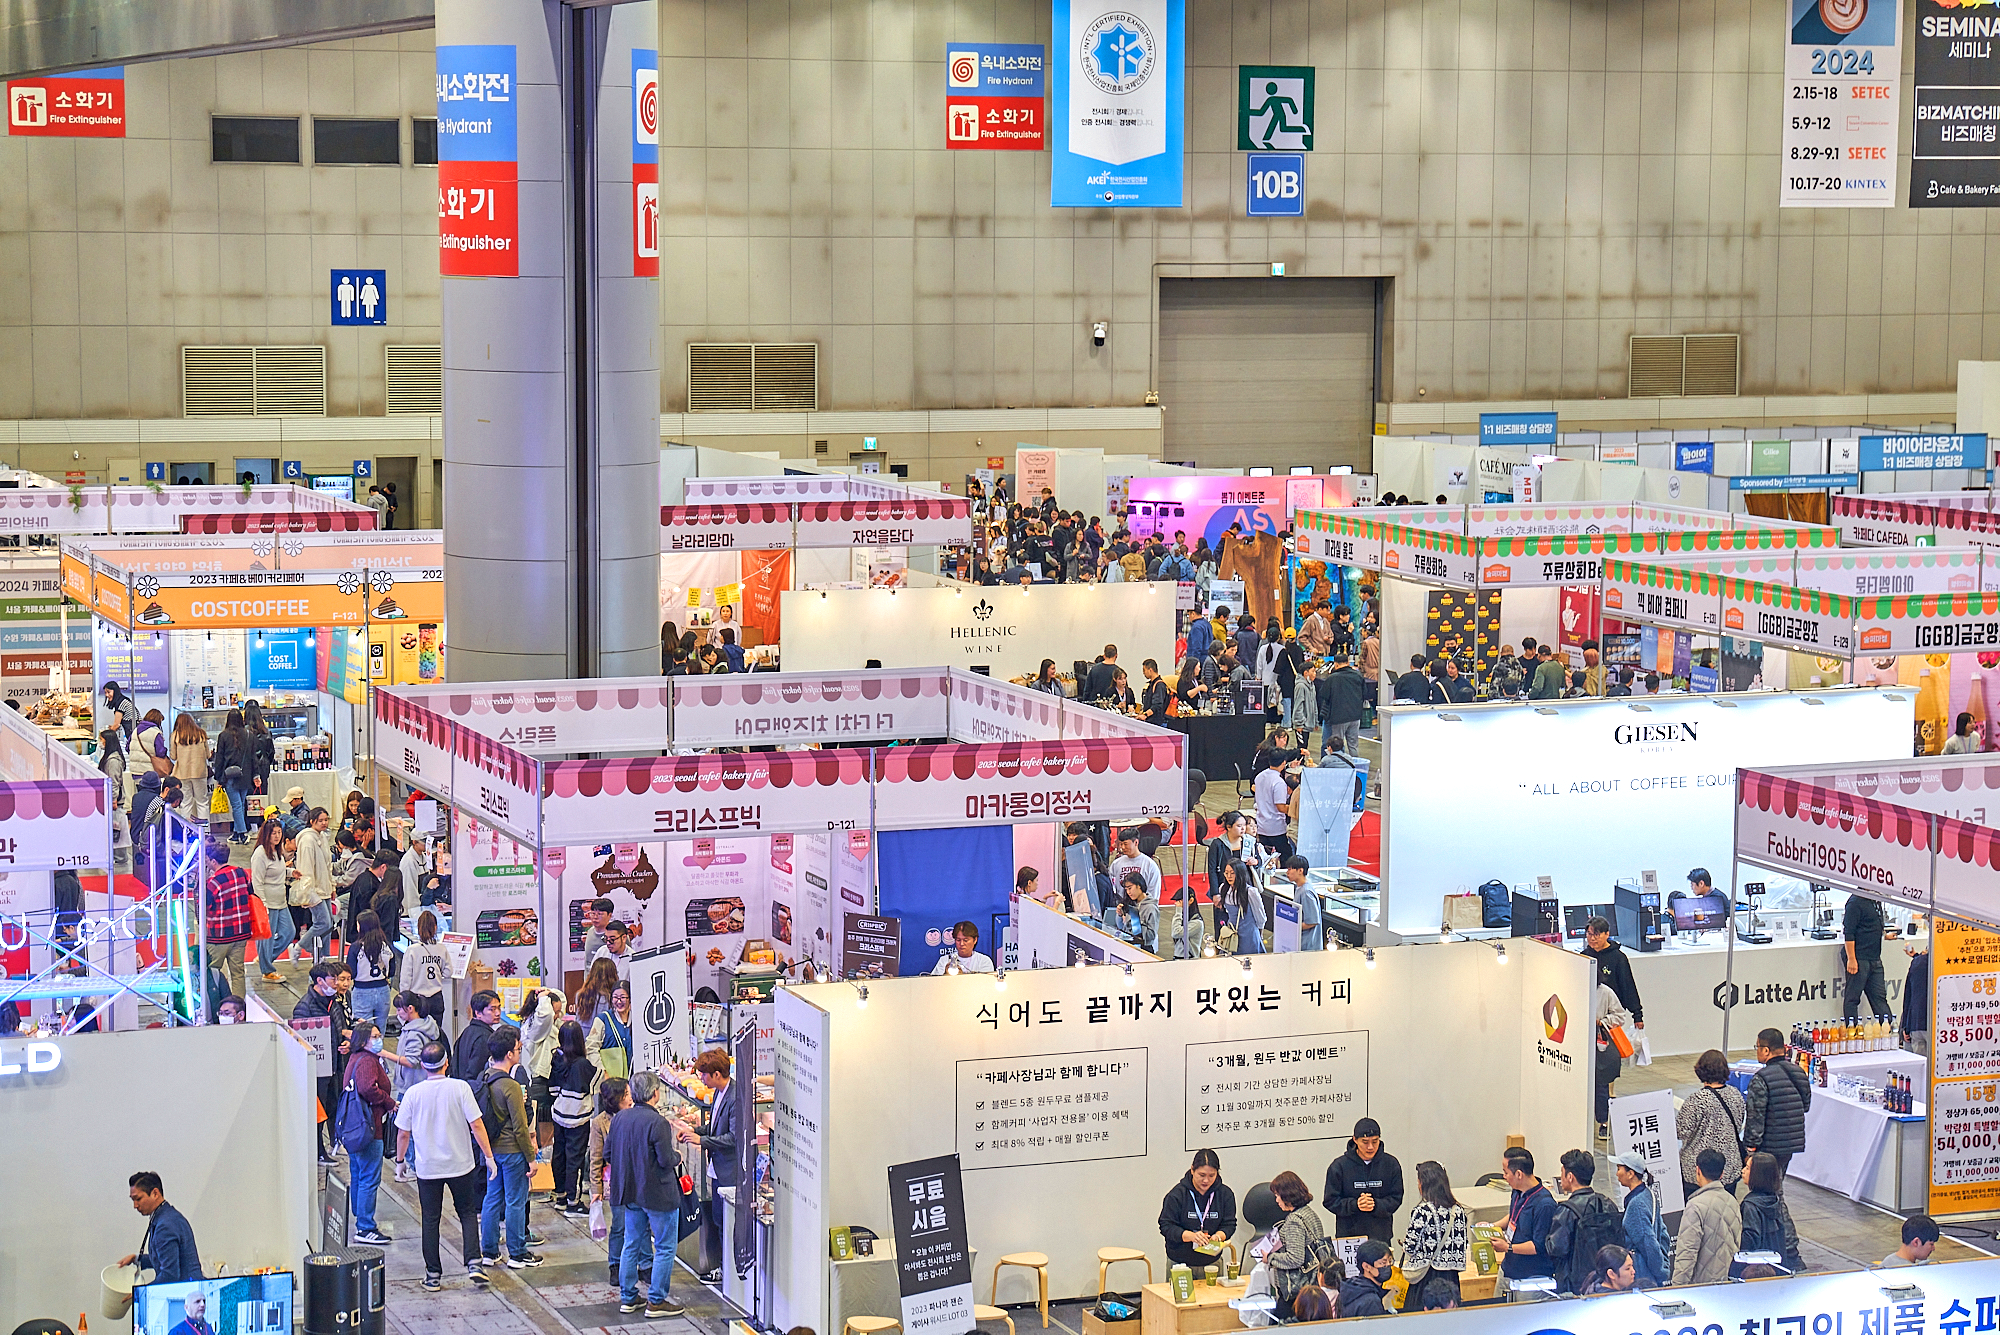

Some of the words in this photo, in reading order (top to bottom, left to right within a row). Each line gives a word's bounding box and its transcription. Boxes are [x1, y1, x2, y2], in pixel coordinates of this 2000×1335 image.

[1092, 14, 1126, 32] CERTIFIED
[1126, 16, 1153, 51] EXHIBITION
[1948, 41, 1991, 59] 세미나
[981, 55, 1041, 71] 옥내소화전
[1811, 49, 1874, 75] 2024
[987, 77, 1001, 86] Fire
[1003, 77, 1033, 86] Hydrant
[56, 91, 113, 109] 소화기
[1793, 87, 1838, 99] 2.15-18
[1852, 87, 1890, 99] SETEC
[49, 115, 66, 123] Fire
[68, 115, 122, 125] Extinguisher
[986, 109, 1034, 125] 소화기
[1791, 117, 1831, 130] 5.9-12
[446, 118, 492, 136] Hydrant
[981, 130, 996, 139] Fire
[997, 130, 1041, 140] Extinguisher
[1941, 125, 1996, 142] 비즈매칭
[1790, 147, 1839, 160] 8.29-9.1
[1848, 147, 1886, 160] SETEC
[1252, 170, 1299, 198] 10B
[1790, 177, 1841, 190] 10.17-20
[1845, 180, 1886, 189] KINTEX
[1940, 185, 1956, 194] Cafe
[1957, 185, 1964, 194] &
[1965, 185, 1989, 195] Bakery
[443, 234, 511, 252] Extinguisher
[1484, 425, 1494, 434] 1:1
[1496, 425, 1527, 434] 비즈매칭
[1529, 423, 1553, 434] 상담장
[1882, 436, 1964, 454] 바이어라운지
[1882, 456, 1894, 468] 1:1
[1896, 455, 1934, 468] 비즈매칭
[1935, 455, 1964, 467] 상담장
[1740, 478, 1775, 488] Sponsored
[1777, 478, 1784, 488] by
[1221, 492, 1235, 504] 뽑기
[1237, 491, 1265, 504] 이벤트존
[852, 529, 914, 544] 자연을담다
[1853, 527, 1875, 543] 카페다
[1876, 530, 1909, 546] CAFEDA
[0, 581, 29, 592] 2024
[190, 574, 217, 584] 2023
[219, 573, 305, 585] 카페&베이커리페어
[191, 599, 309, 618] COSTCOFFEE
[1647, 593, 1662, 616] 비어
[1664, 596, 1688, 620] 컴퍼니
[332, 612, 357, 621] F-121
[951, 626, 1017, 638] HELLENIC
[1758, 611, 1819, 643] [GGB]금군양조
[1915, 621, 2000, 648] [GGB]금군양
[965, 645, 1002, 653] WINE
[268, 655, 290, 663] COST
[268, 662, 293, 670] COFFEE
[1614, 721, 1698, 745] GIESEN
[978, 759, 996, 770] 2023
[997, 758, 1019, 769] seoul
[1042, 756, 1069, 769] bakery
[1070, 754, 1088, 767] fair
[653, 774, 673, 784] 2023
[674, 773, 697, 783] seoul
[722, 769, 752, 783] bakery
[753, 767, 769, 781] fair
[1533, 783, 1559, 796] ALL
[1570, 780, 1620, 794] ABOUT
[1630, 776, 1687, 791] COFFEE
[966, 790, 1093, 819] 마카롱의정석
[1142, 805, 1171, 816] D-122
[653, 804, 761, 834] 크리스프빅
[827, 819, 856, 831] D-121
[57, 855, 90, 866] D-118
[1767, 831, 1848, 874] Fabbri1905
[1851, 853, 1895, 887] Korea
[1902, 886, 1924, 900] C-127
[426, 965, 436, 981] 8
[1744, 981, 1793, 1004] Latte
[1797, 979, 1827, 1001] Art
[1832, 974, 1902, 1000] Fary
[1972, 977, 1997, 995] 8평
[976, 999, 1063, 1030] 식어도
[1085, 990, 1174, 1025] 끝까지
[1196, 985, 1282, 1015] 맛있는
[1301, 978, 1353, 1008] 커피
[1951, 1001, 1973, 1012] 정상가
[1946, 1015, 1974, 1027] 박람회
[1253, 1052, 1276, 1066] 원두
[1279, 1049, 1303, 1063] 반값
[1305, 1046, 1346, 1061] 이벤트”
[1060, 1065, 1083, 1080] 함께
[1086, 1062, 1129, 1077] 합니다”
[1216, 1081, 1241, 1093] 전시회
[1244, 1079, 1260, 1091] 기간
[1263, 1078, 1288, 1090] 상담한
[1290, 1074, 1333, 1086] 카페사장님
[991, 1098, 1018, 1110] 블렌드
[1020, 1096, 1034, 1108] 5종
[1037, 1093, 1072, 1106] 원두무료
[1074, 1091, 1110, 1104] 샘플제공
[1965, 1084, 1996, 1102] 15평
[1216, 1101, 1234, 1113] 11월
[1237, 1099, 1273, 1112] 30일까지
[1274, 1096, 1308, 1109] 첫주문한
[1310, 1092, 1352, 1105] 카페사장님
[991, 1116, 1026, 1130] 함께커피
[1091, 1110, 1109, 1122] 이용
[1111, 1108, 1129, 1120] 혜택
[1945, 1108, 1968, 1118] 정상가
[1215, 1121, 1240, 1133] 첫주문
[1244, 1119, 1252, 1131] 후
[1254, 1117, 1276, 1130] 3개월
[1279, 1116, 1295, 1128] 동안
[1297, 1114, 1316, 1125] 50%
[1318, 1113, 1335, 1124] 할인
[1629, 1114, 1659, 1138] 카톡
[1944, 1122, 1971, 1134] 박람회
[991, 1138, 1009, 1150] 최대
[1010, 1137, 1026, 1148] 8%
[1027, 1135, 1045, 1147] 적립
[1055, 1132, 1073, 1145] 매월
[1075, 1130, 1110, 1143] 할인쿠폰
[908, 1178, 945, 1205] 무료
[911, 1205, 946, 1232] 시음
[911, 1304, 928, 1316] 2023
[929, 1299, 949, 1312] 파나마
[949, 1312, 959, 1322] LOT
[960, 1310, 968, 1320] 03
